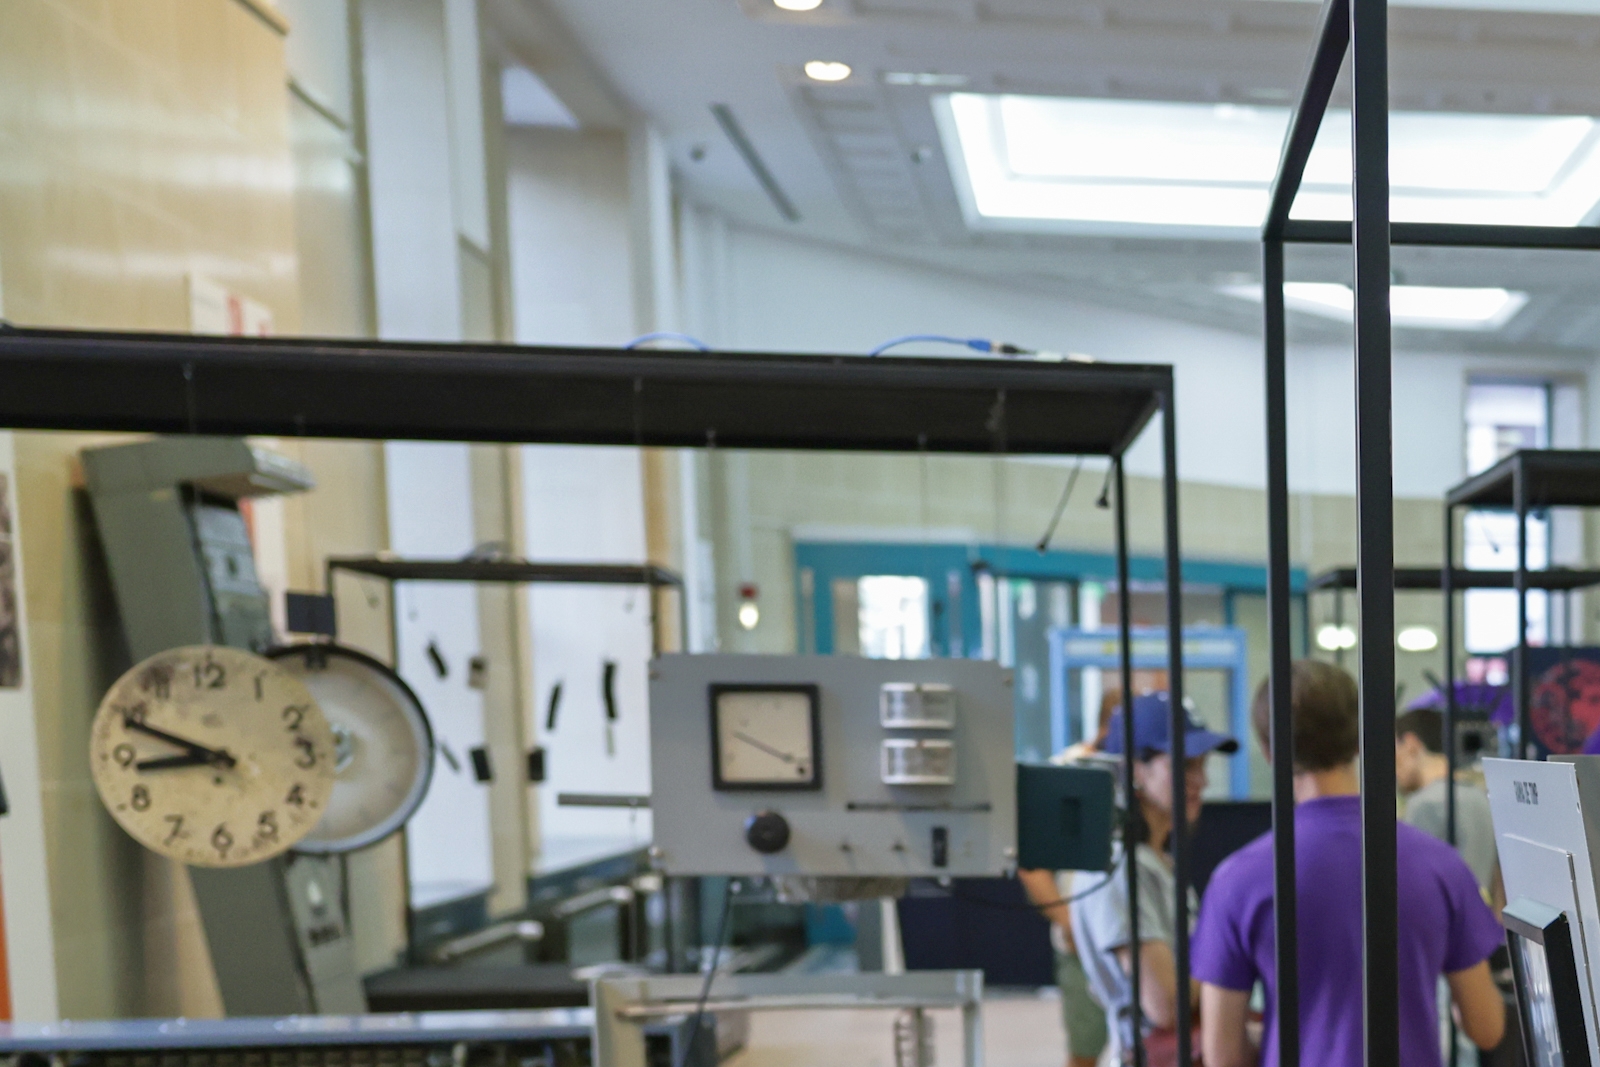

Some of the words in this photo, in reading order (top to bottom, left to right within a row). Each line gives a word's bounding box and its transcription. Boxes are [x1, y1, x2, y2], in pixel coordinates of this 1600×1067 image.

[193, 662, 226, 689] 12
[282, 705, 303, 731] 2
[113, 742, 136, 770] 9
[294, 737, 316, 769] 3
[130, 783, 152, 812] 8
[285, 784, 305, 806] 4
[163, 814, 184, 846] 7
[211, 821, 234, 851] 6
